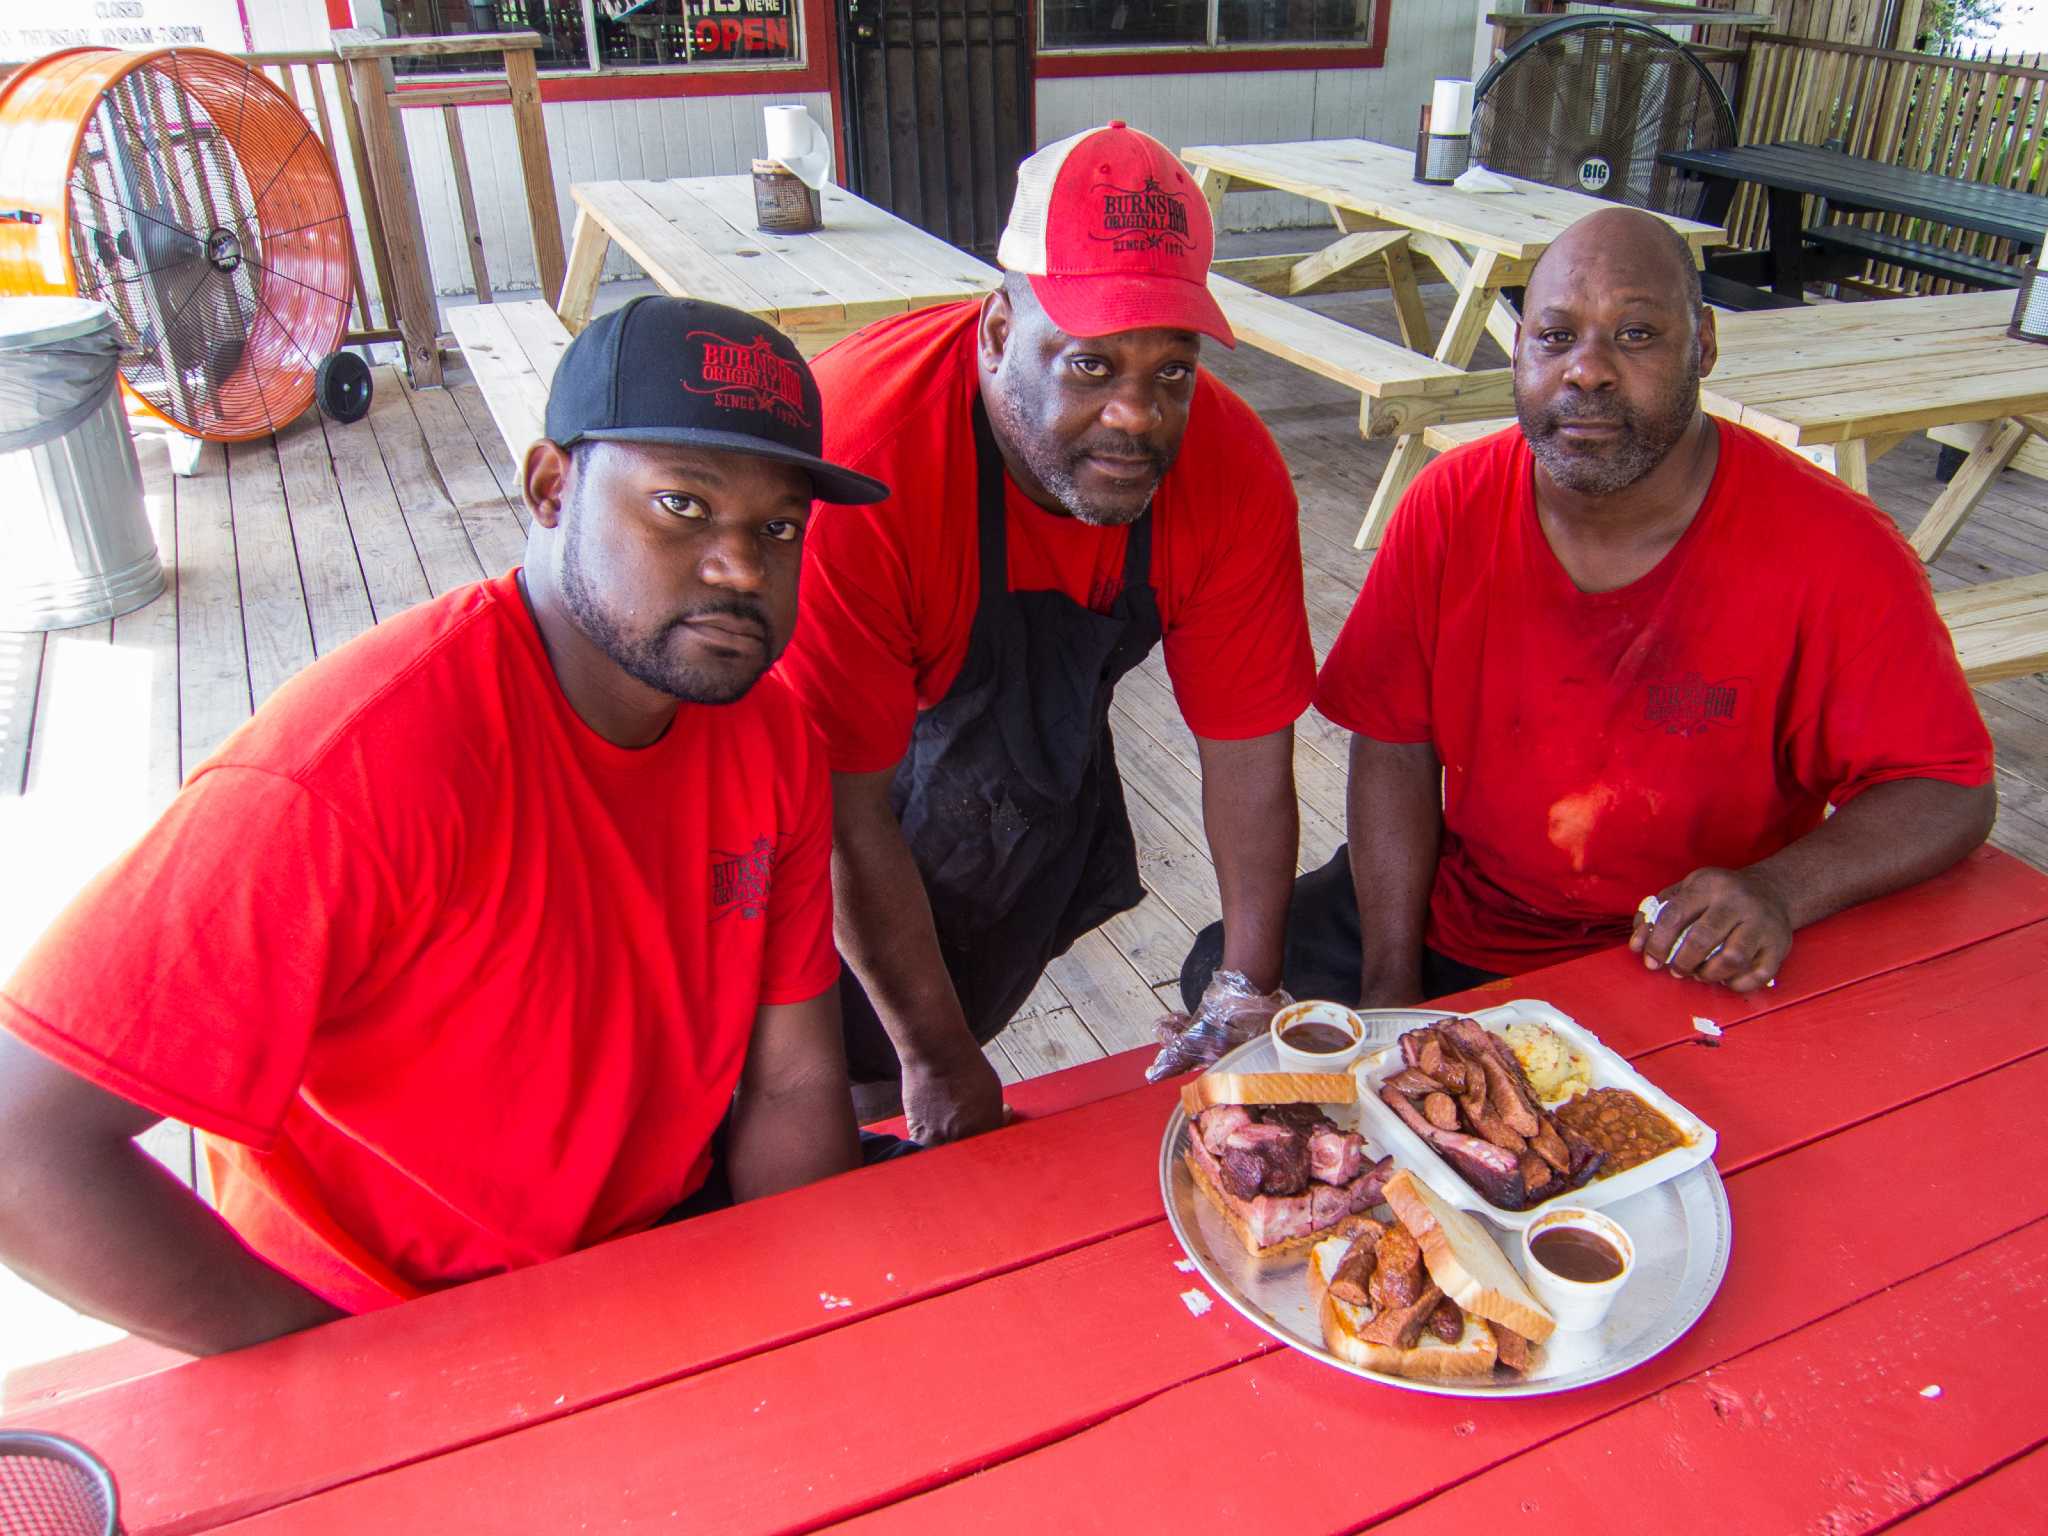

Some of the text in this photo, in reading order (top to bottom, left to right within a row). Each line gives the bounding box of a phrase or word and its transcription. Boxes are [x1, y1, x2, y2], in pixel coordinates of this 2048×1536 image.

[95, 1, 145, 18] CLOSED
[695, 17, 788, 52] OPEN
[1583, 163, 1607, 178] BIG
[1103, 193, 1167, 214] BURNS
[1103, 213, 1166, 230] ORIGINAL
[1113, 239, 1146, 252] SINCE
[703, 342, 778, 379] BURNS
[713, 392, 756, 411] SINCE
